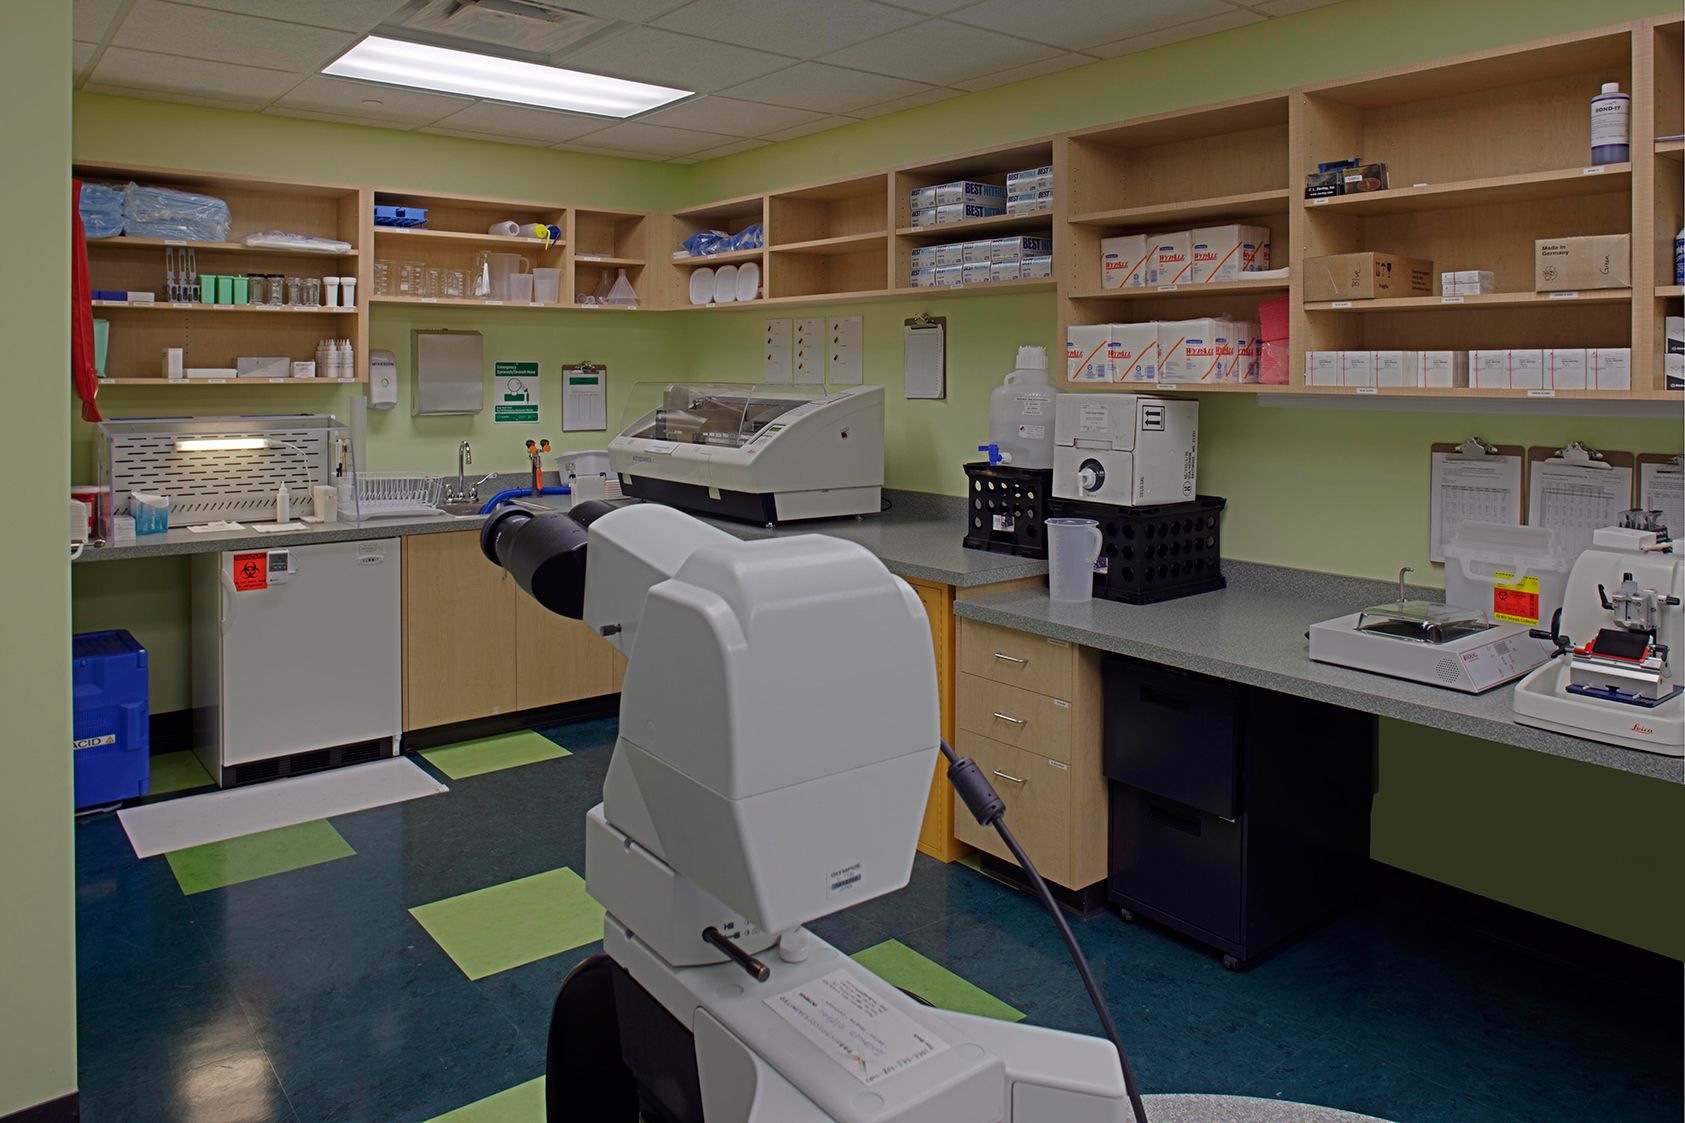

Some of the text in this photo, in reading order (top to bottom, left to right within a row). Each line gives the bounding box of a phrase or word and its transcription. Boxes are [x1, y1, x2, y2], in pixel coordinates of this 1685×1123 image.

[1595, 105, 1621, 113] BOND-IT
[1038, 167, 1049, 175] BEST
[965, 182, 983, 196] BEST
[1038, 191, 1050, 199] BEST
[966, 205, 984, 217] BEST
[1023, 237, 1040, 250] BEST
[1352, 263, 1361, 288] Blue
[1631, 723, 1654, 734] Leica
[73, 738, 102, 749] ACID
[831, 863, 860, 878] OLYMPUS
